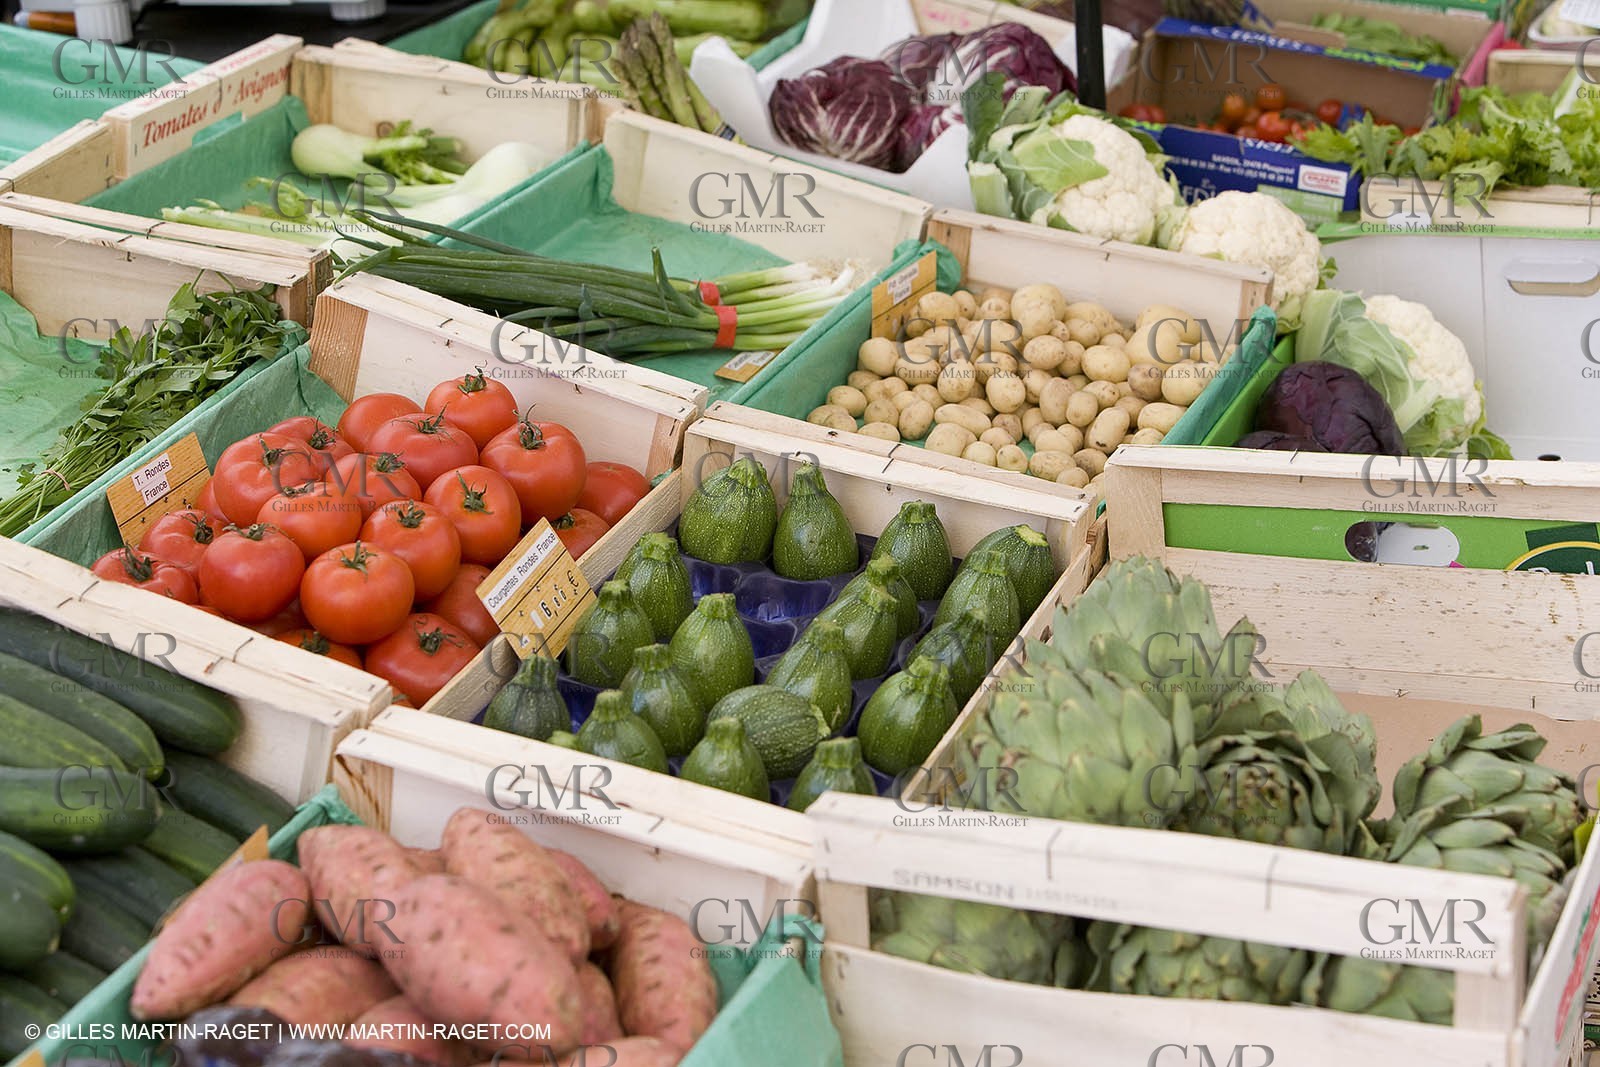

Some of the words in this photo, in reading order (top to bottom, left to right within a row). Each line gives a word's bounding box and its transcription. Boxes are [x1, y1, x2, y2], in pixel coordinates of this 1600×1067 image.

[143, 103, 208, 148] Tomates
[134, 475, 144, 486] T.
[144, 459, 170, 480] Rondes
[144, 480, 168, 501] France
[487, 575, 519, 608] Courgettes
[517, 552, 539, 577] Rondes
[537, 532, 557, 555] France
